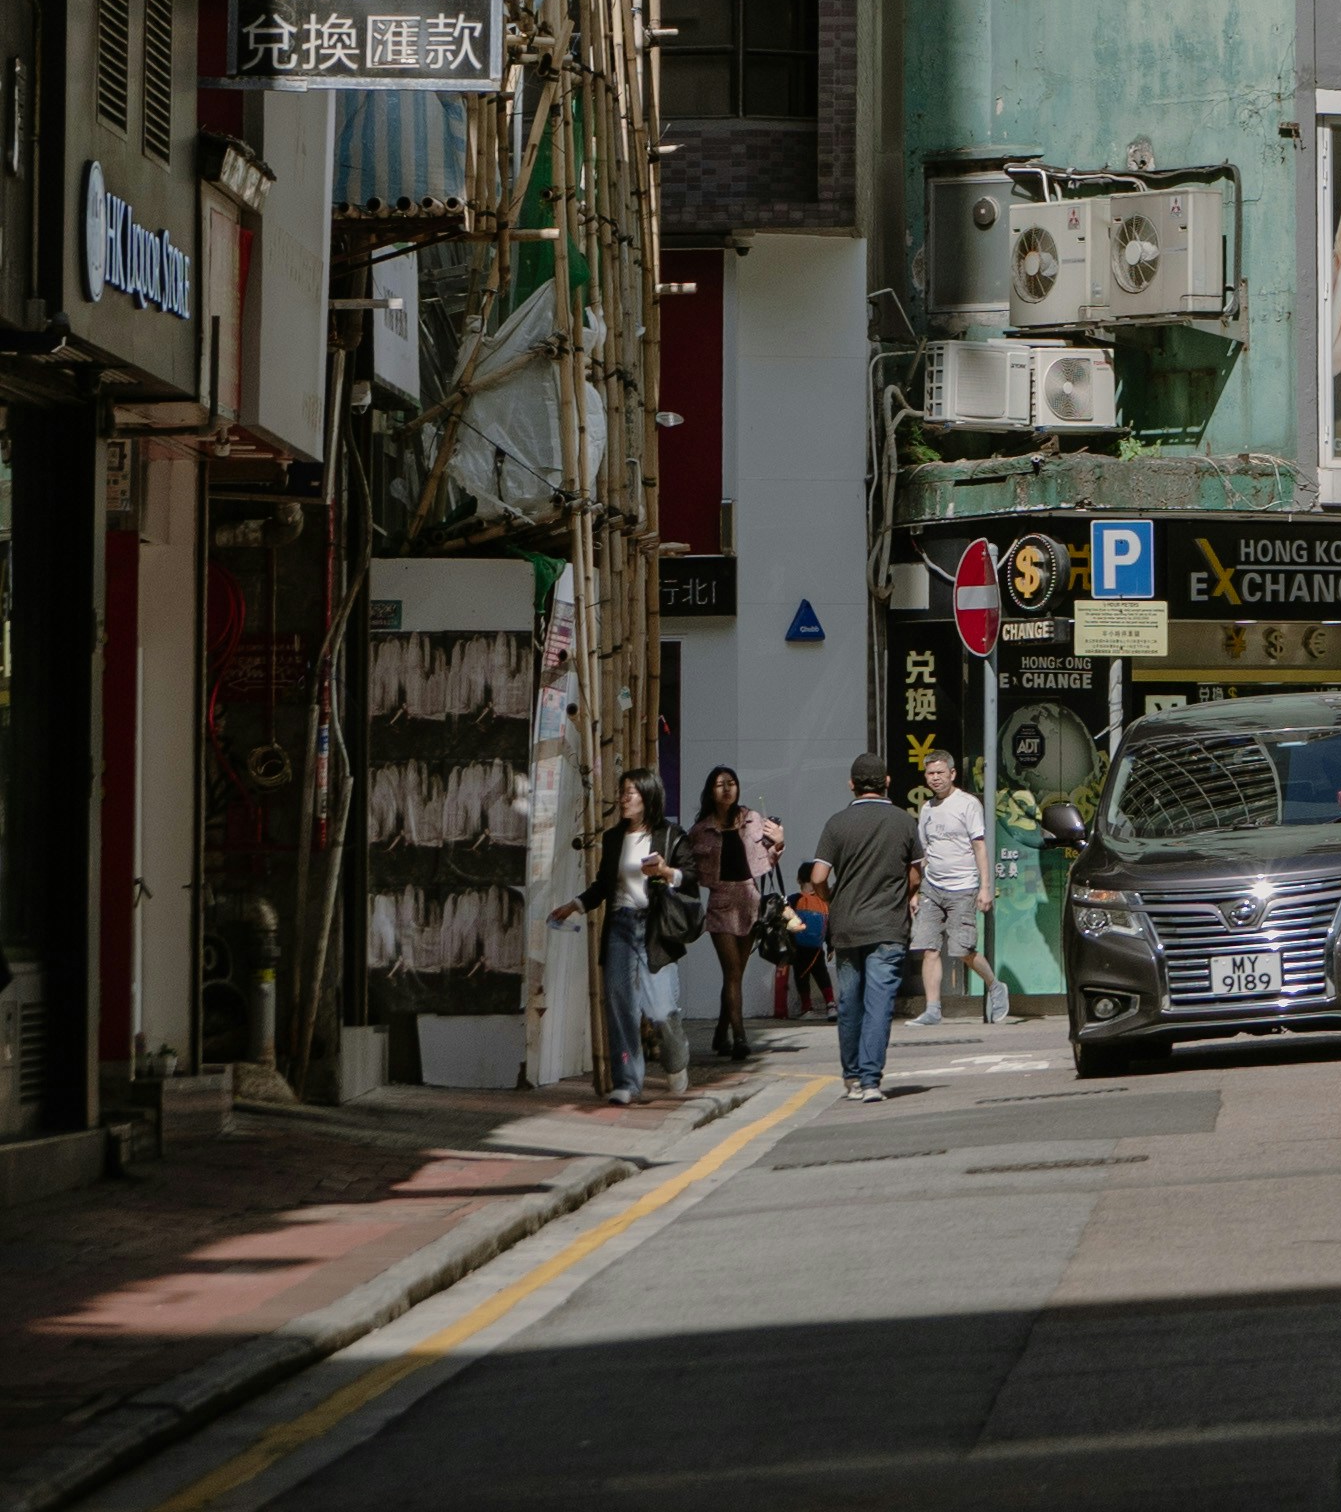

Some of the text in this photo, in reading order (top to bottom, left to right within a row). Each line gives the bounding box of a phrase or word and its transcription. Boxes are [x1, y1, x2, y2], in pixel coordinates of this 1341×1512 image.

[105, 192, 191, 320] HK LIQUOR STORE
[1103, 529, 1141, 590] P
[1239, 538, 1308, 564] HONG
[1021, 656, 1056, 669] HONG
[1016, 738, 1041, 754] ADT
[1232, 956, 1258, 974] MY
[1222, 973, 1271, 992] 9189
